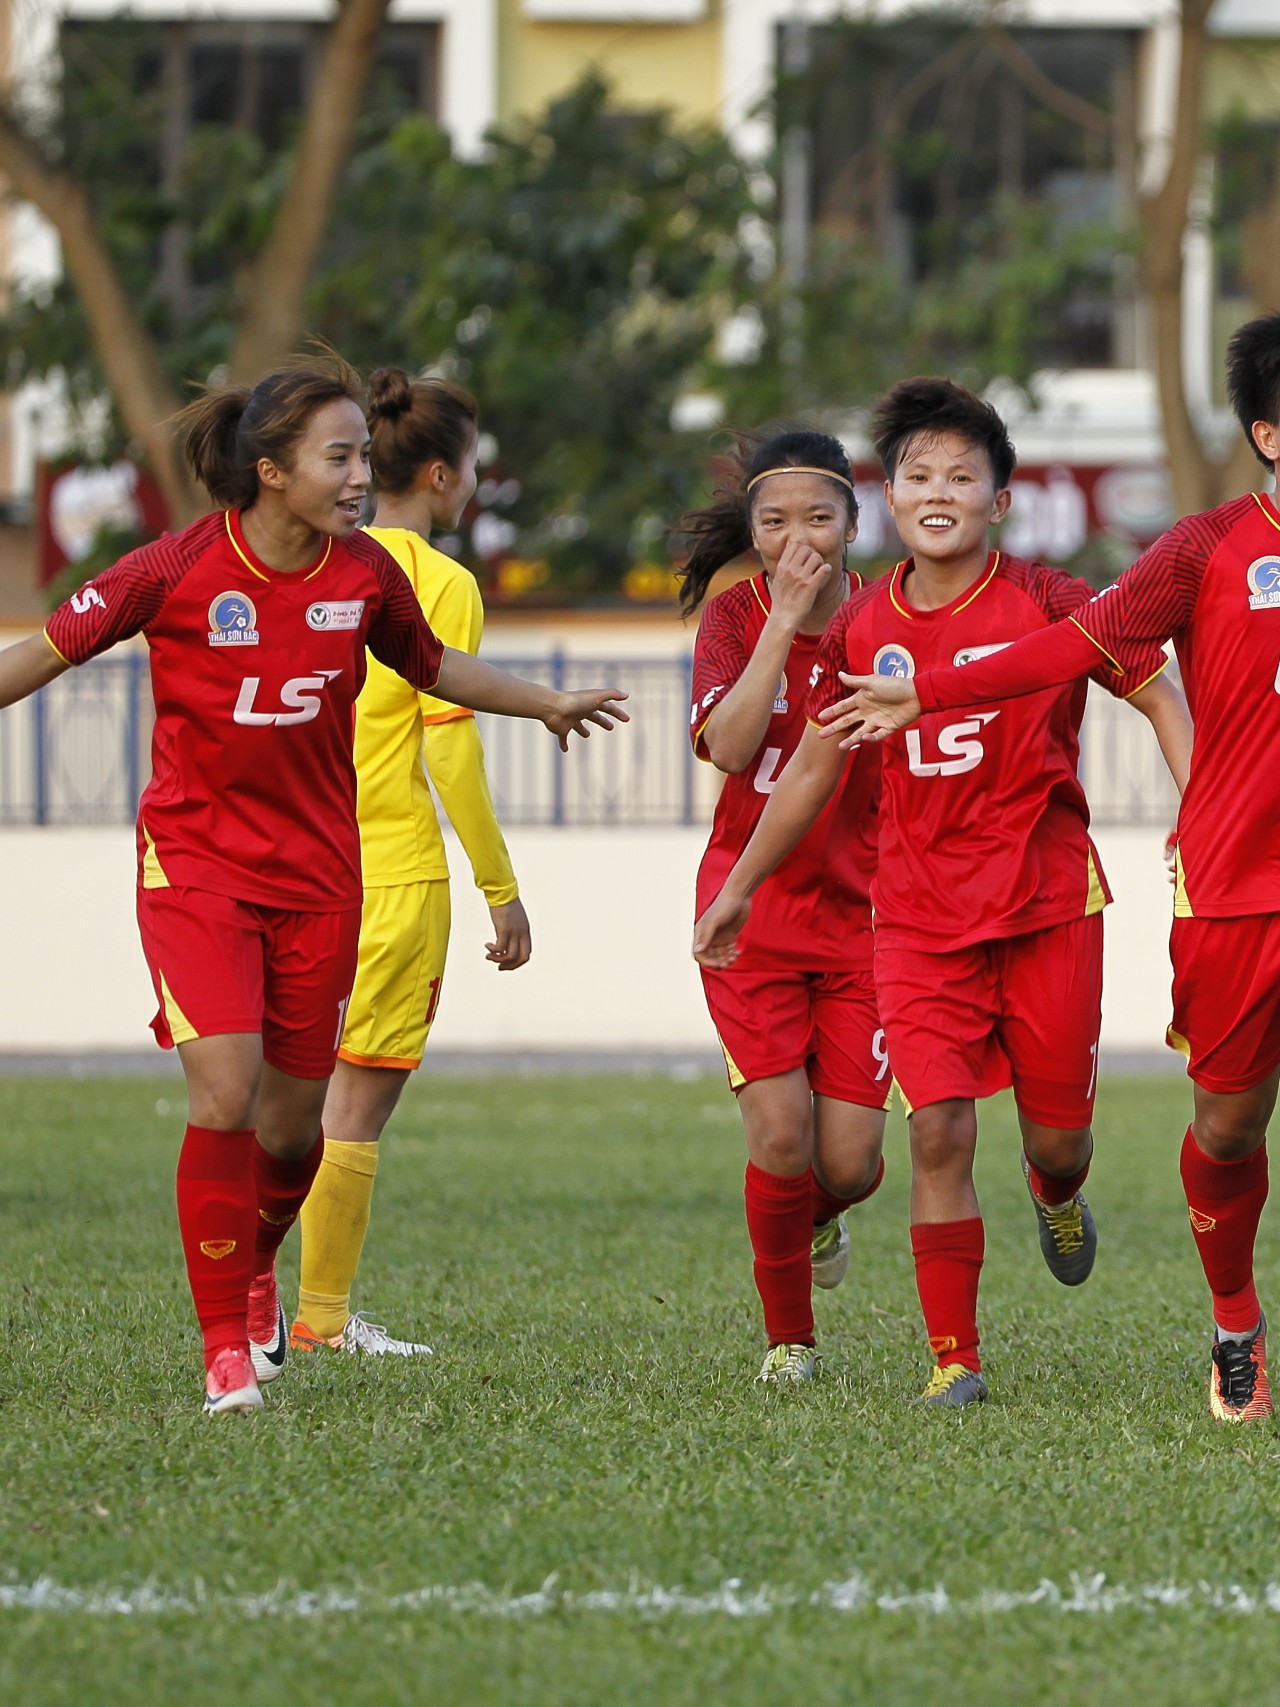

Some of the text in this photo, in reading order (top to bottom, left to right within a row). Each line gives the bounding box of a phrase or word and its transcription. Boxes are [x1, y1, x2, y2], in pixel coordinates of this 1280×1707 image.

[233, 677, 325, 726] LS
[905, 720, 984, 777] LS
[872, 1028, 889, 1081] 9
